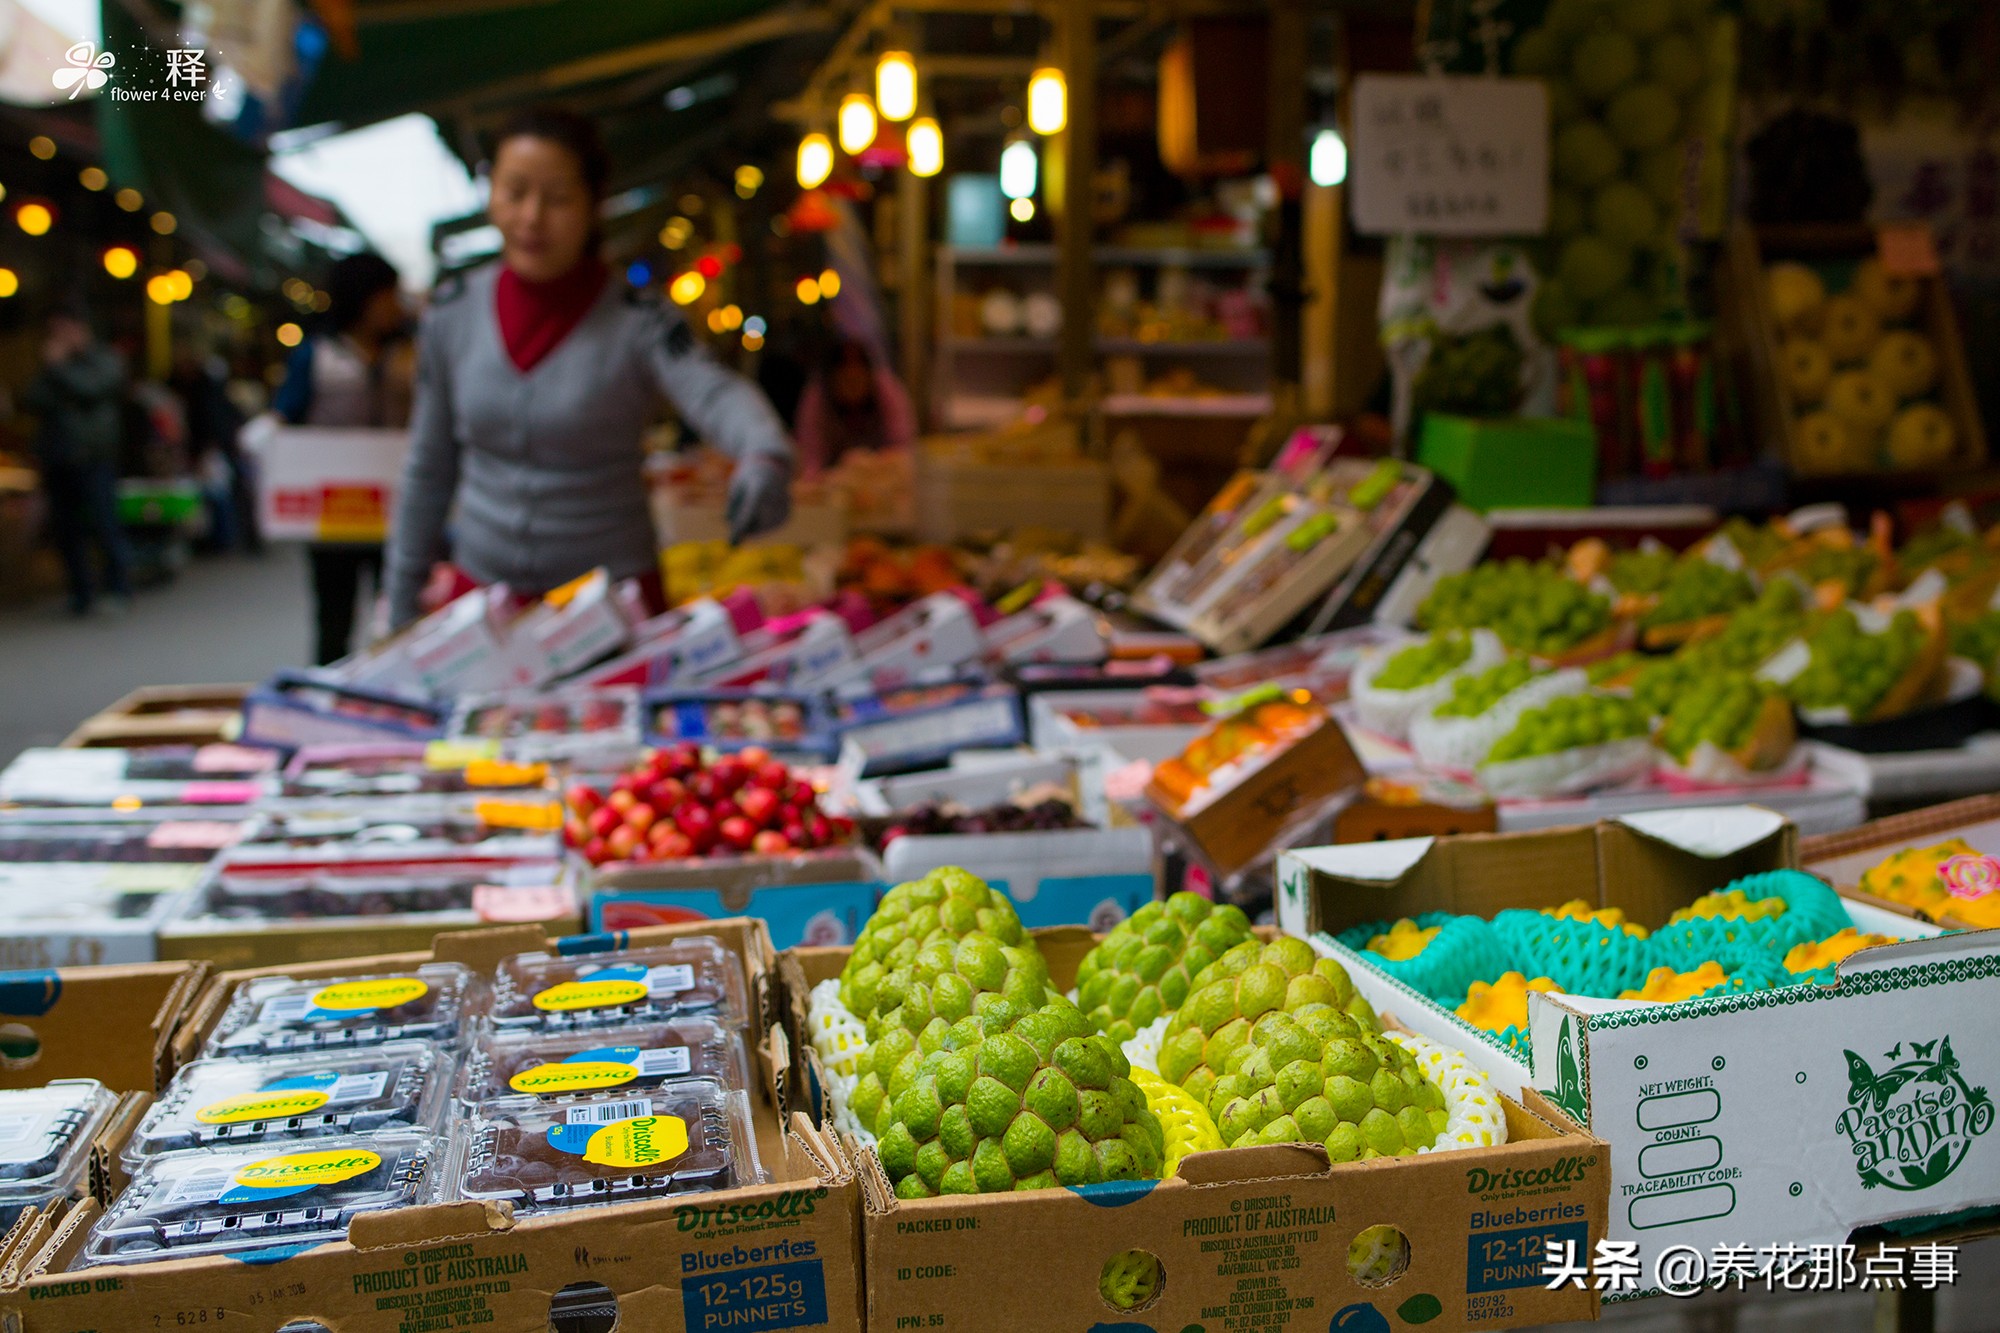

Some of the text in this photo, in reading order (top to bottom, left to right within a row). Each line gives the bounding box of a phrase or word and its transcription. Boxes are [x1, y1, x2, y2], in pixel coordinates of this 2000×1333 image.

[1638, 1075, 1714, 1097] NET WEIGHT:
[1655, 1126, 1701, 1142] COUNT:
[1621, 1167, 1742, 1196] TRACEABILITY CODE:
[1244, 1195, 1291, 1211] DRISCOLL'S
[1480, 1185, 1571, 1202] Only the Finest Berries
[897, 1217, 981, 1234] PACKED ON:
[1183, 1206, 1336, 1237] PRODUCT OF AUSTRALIA
[1470, 1202, 1585, 1229] Blueberries
[694, 1218, 800, 1240] Only the Finest Berries
[1200, 1230, 1318, 1253] DRISCOLL'S AUSTRALIA PTY LTD
[420, 1243, 474, 1264] DRISCOLL'S
[681, 1239, 816, 1273] Blueberries
[1224, 1245, 1295, 1263] 275 ROBINSONS RD
[353, 1253, 529, 1294] PRODUCT OF AUSTRALIA
[898, 1264, 957, 1280] ID CODE:
[1267, 1259, 1280, 1271] VIC
[1281, 1257, 1300, 1269] 3023
[29, 1277, 124, 1300] PACKED ON:
[700, 1274, 802, 1308] 12-125g
[1237, 1278, 1267, 1291] GROWN
[376, 1280, 510, 1311] DRISCOLL'S AUSTRALIA PTY LTD
[1230, 1288, 1287, 1304] COSTA BERRIES
[1467, 1295, 1506, 1309] 169792
[405, 1297, 486, 1321] 275 ROBINSONS RD
[455, 1312, 470, 1326] VIC
[472, 1309, 494, 1323] 3023
[705, 1300, 806, 1330] PUNNETS
[1201, 1305, 1228, 1319] RANGE
[1275, 1299, 1294, 1312] NSW
[1467, 1306, 1514, 1321] 5547423
[897, 1314, 944, 1329] IPN: 55
